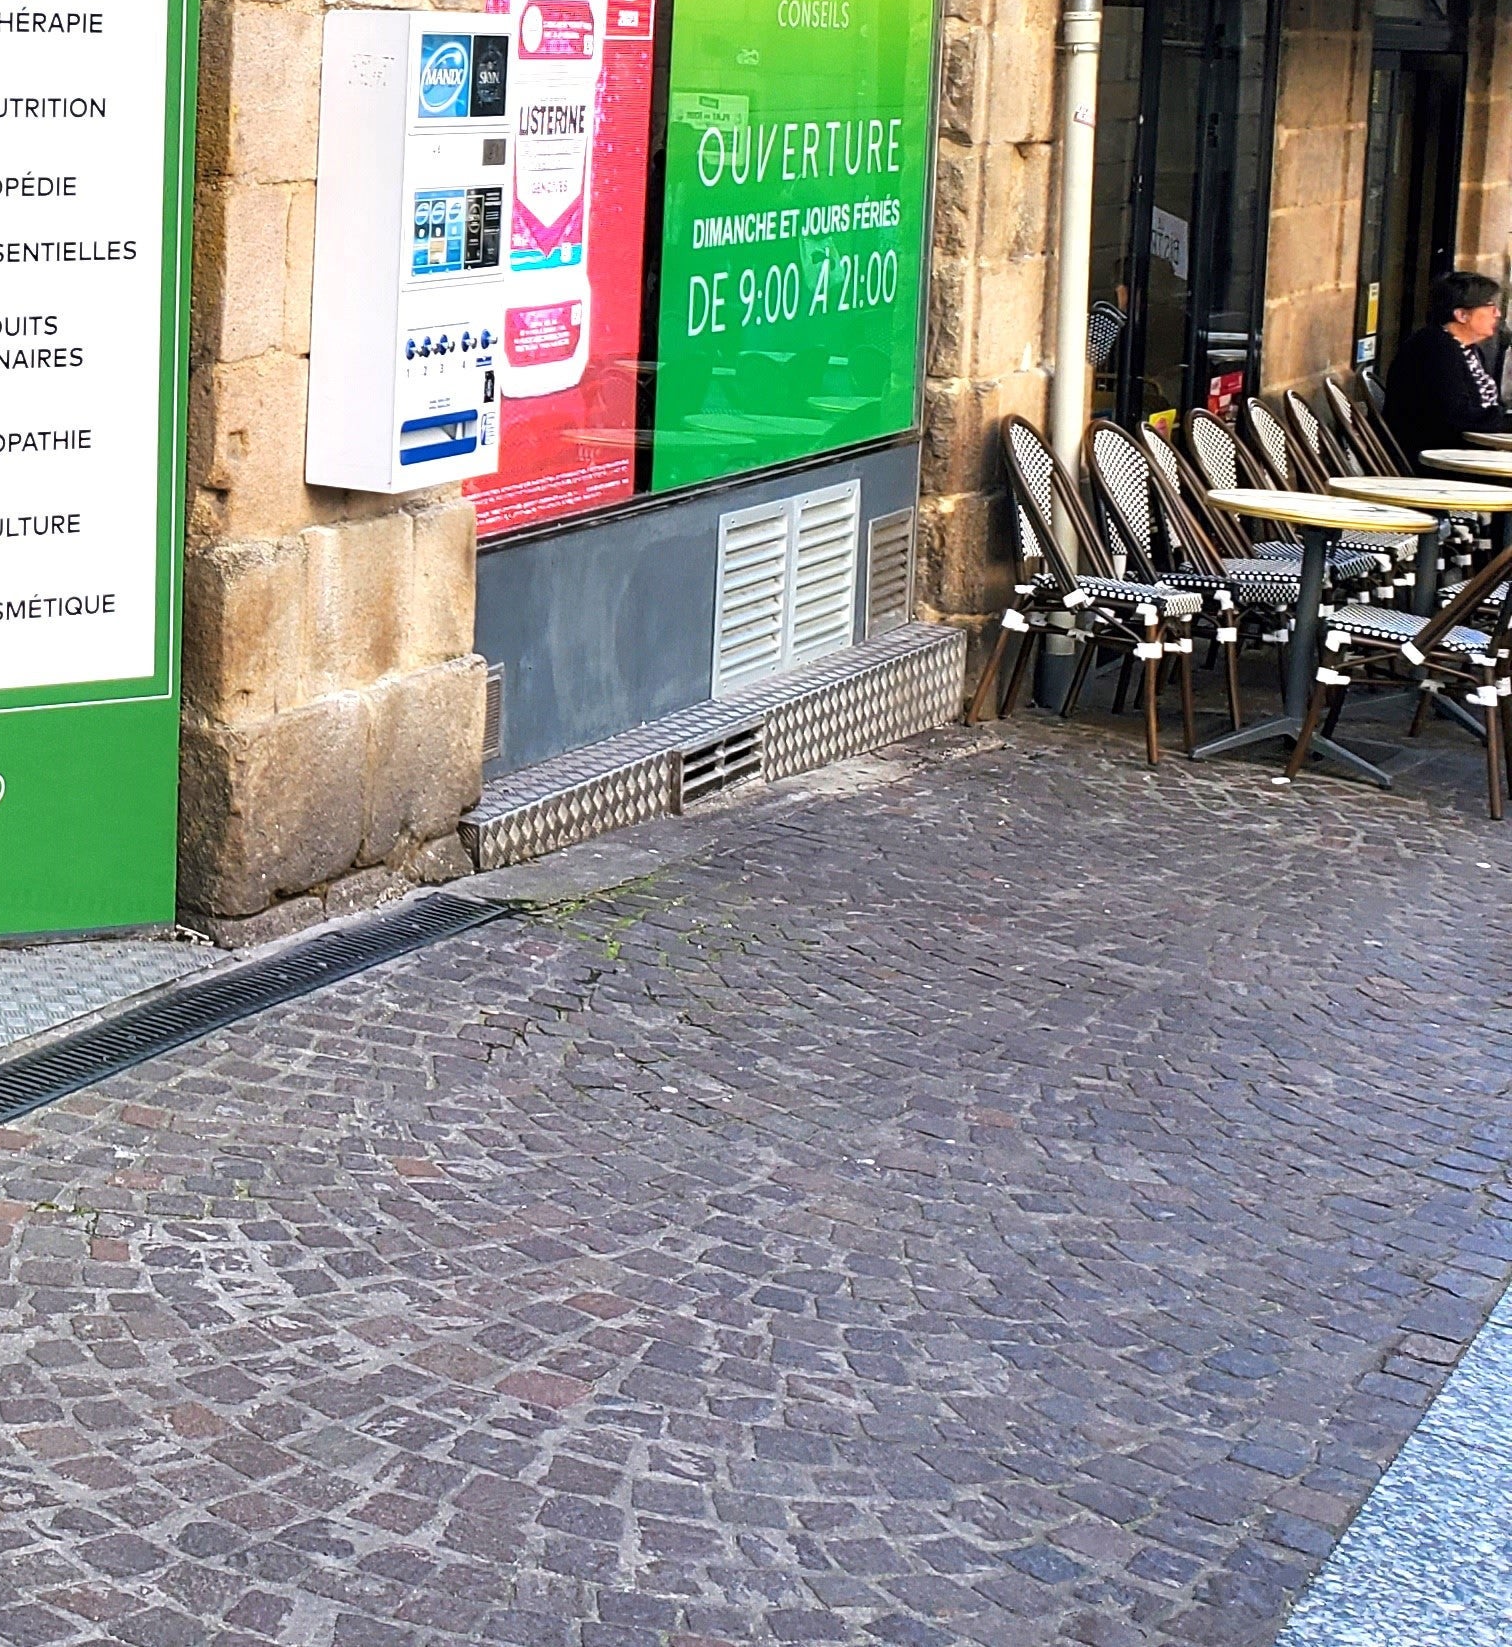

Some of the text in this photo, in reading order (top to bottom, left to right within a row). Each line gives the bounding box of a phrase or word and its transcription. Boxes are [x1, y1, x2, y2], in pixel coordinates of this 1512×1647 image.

[777, 0, 850, 29] CONSEILS
[425, 68, 464, 86] MANIX
[519, 106, 586, 135] LISTERINE
[698, 118, 902, 187] OUVERTURE
[693, 193, 901, 249] DIMANCHE ET JOURS FÉRIÉS
[688, 271, 729, 337] DE
[739, 262, 800, 327] 9:00
[837, 249, 898, 312] 21:00
